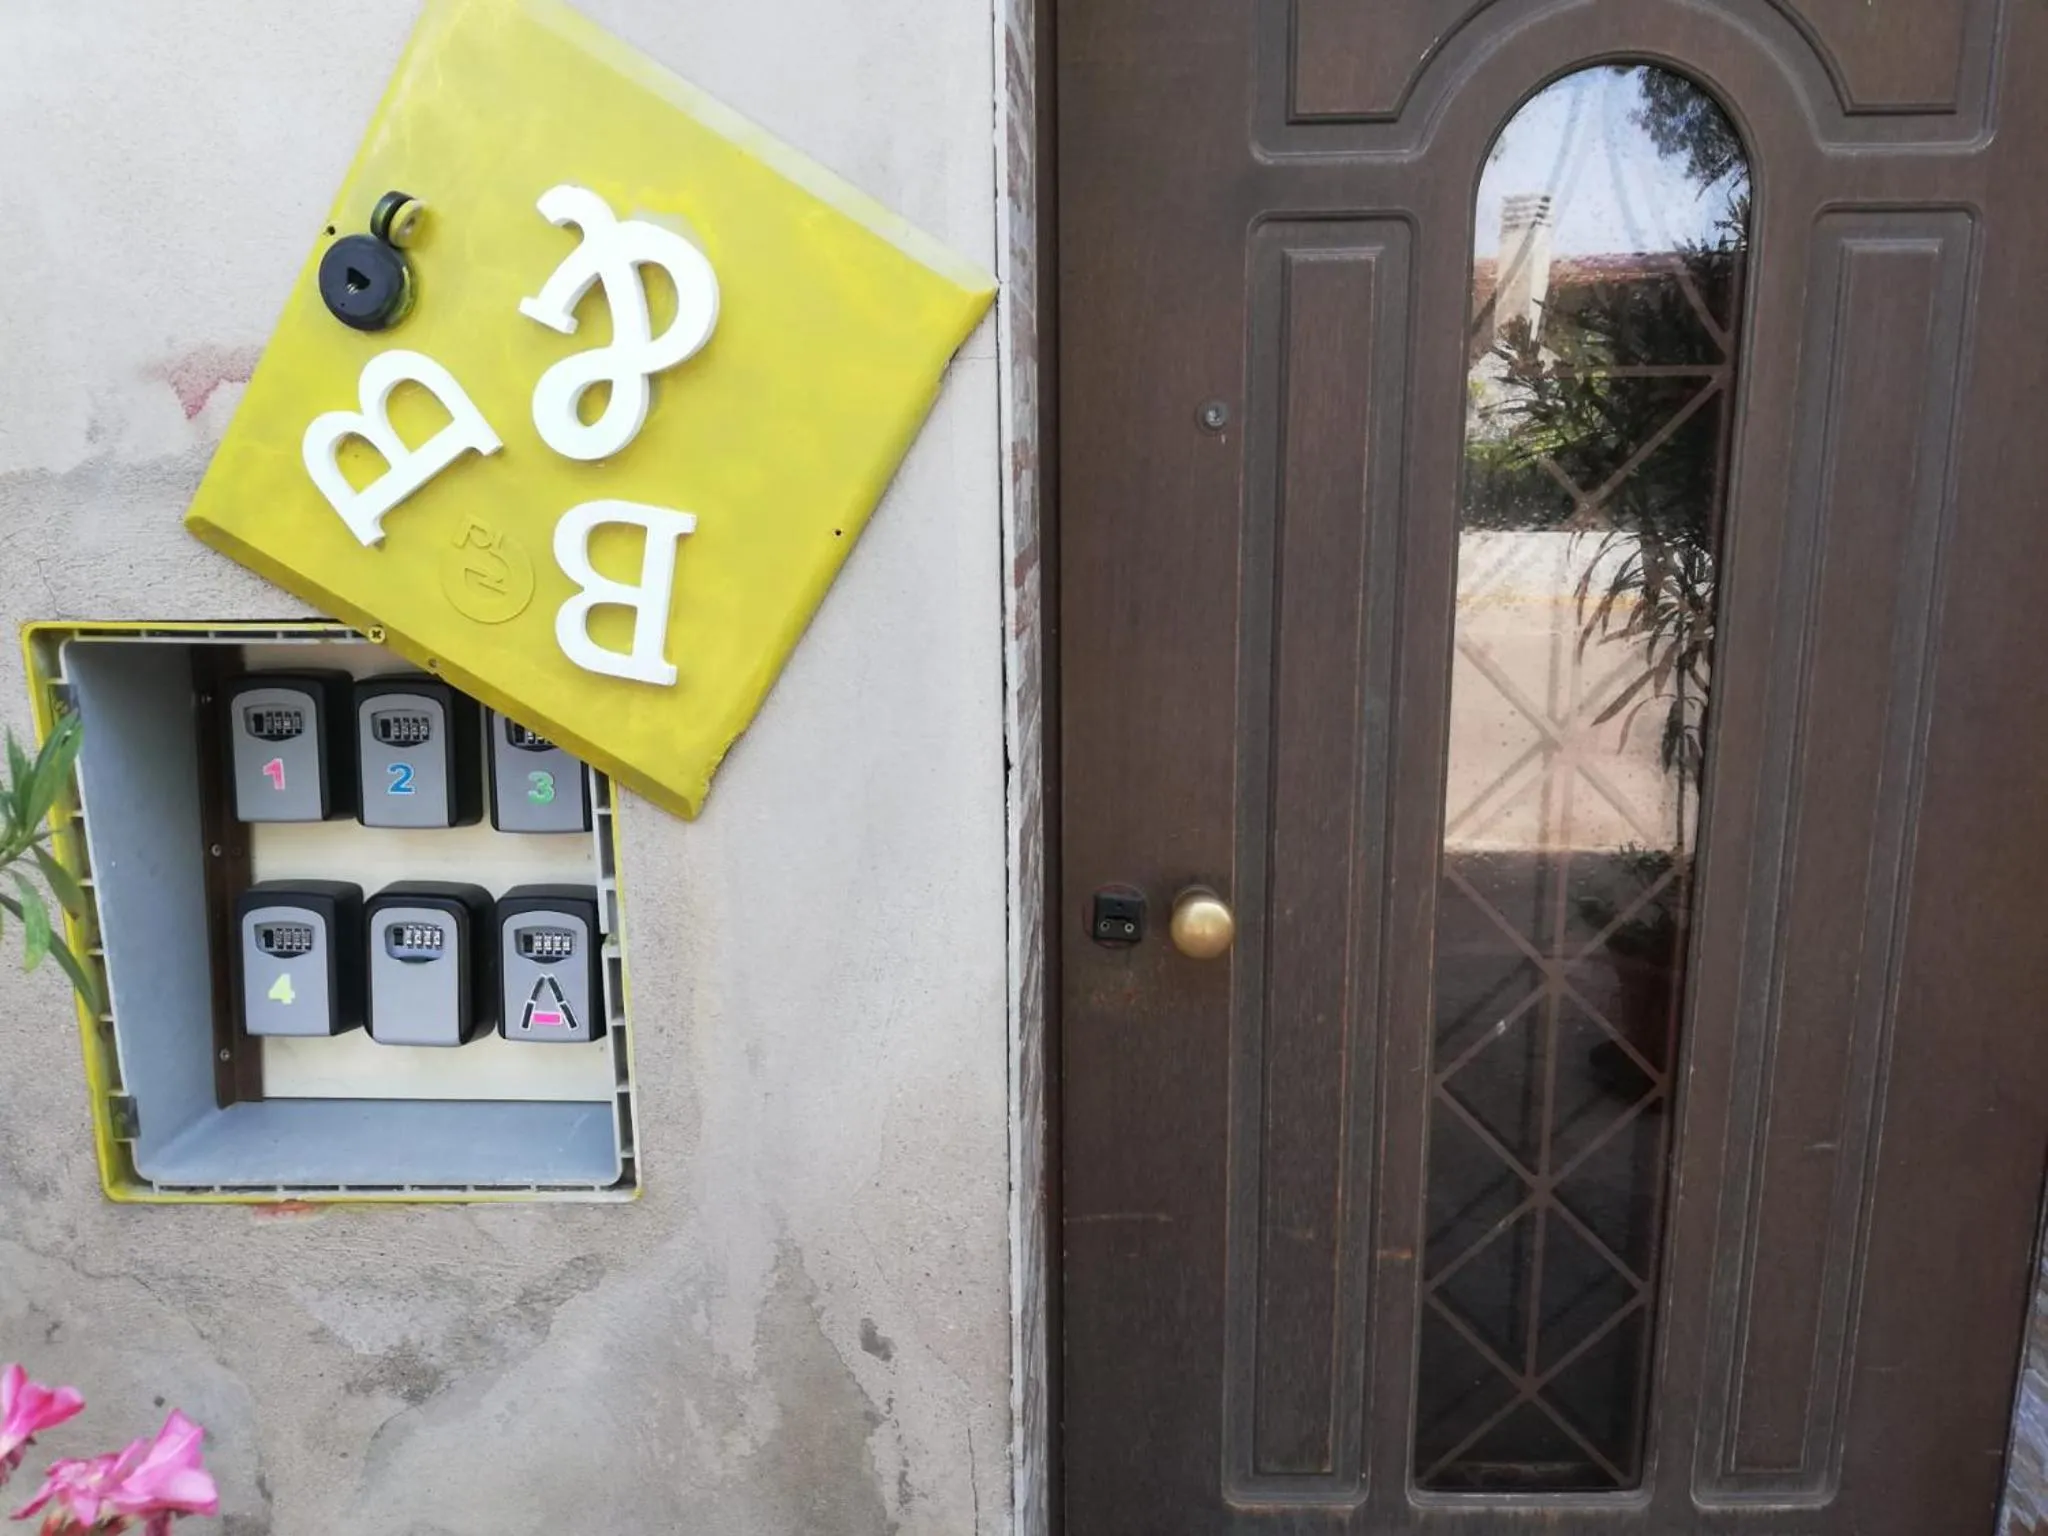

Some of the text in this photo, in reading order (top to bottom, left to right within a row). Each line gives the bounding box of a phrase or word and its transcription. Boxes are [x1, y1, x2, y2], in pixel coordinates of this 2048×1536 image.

[262, 757, 285, 790] 1
[387, 762, 415, 795] 2
[527, 771, 555, 805] 3
[268, 973, 296, 1005] 4
[519, 973, 580, 1031] A
